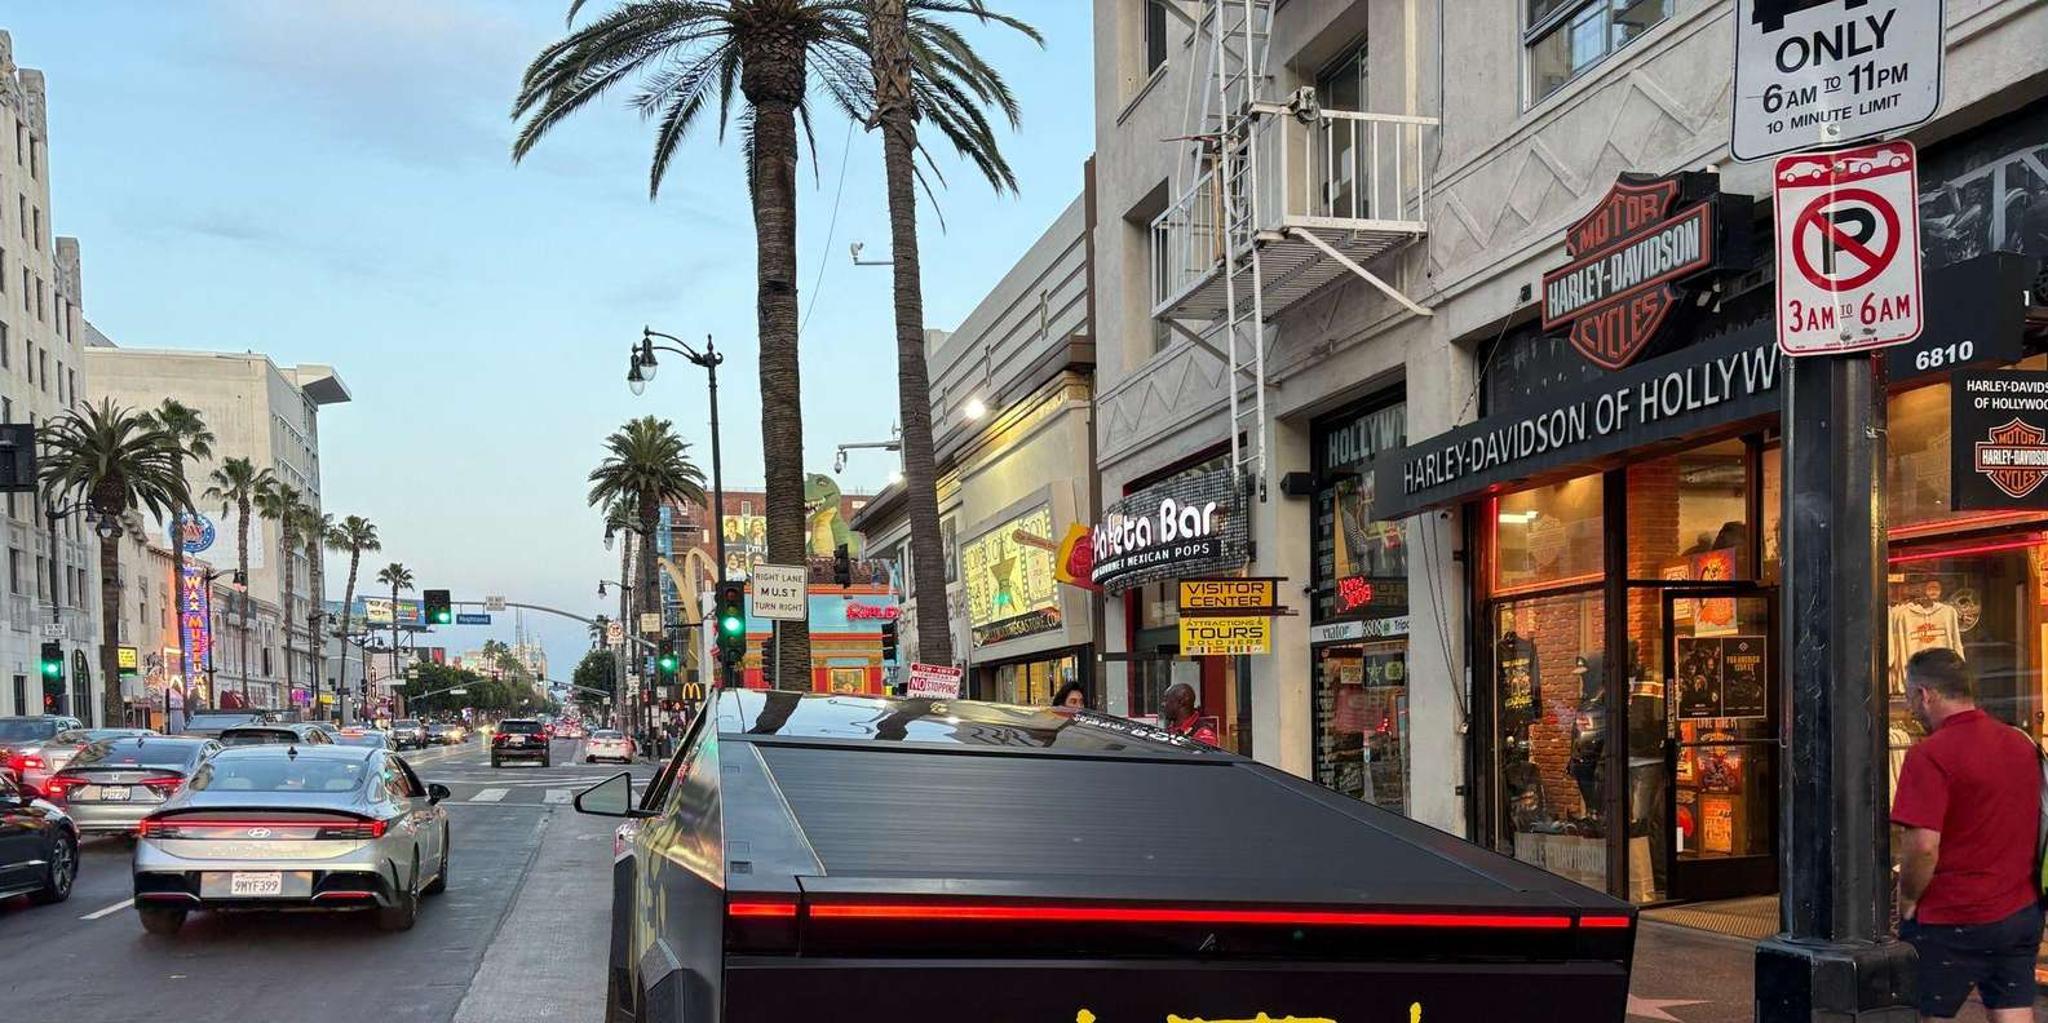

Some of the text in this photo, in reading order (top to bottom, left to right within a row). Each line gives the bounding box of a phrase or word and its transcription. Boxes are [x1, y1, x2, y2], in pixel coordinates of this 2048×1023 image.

[1775, 8, 1896, 73] ONLY
[1763, 61, 1908, 113] 6AM TO 11PM
[1767, 93, 1902, 134] 10 MINUTE LIMIT
[1579, 193, 1660, 249] MOTOR
[1548, 217, 1699, 319] HARLEY-DAVIDSON
[1581, 291, 1659, 357] CYCLES
[1789, 291, 1911, 333] 3AM TO 6AM
[1915, 340, 1974, 371] 6810
[1974, 397, 1990, 409] OF
[1404, 342, 1778, 494] HARLEY-DAVIDSON OF HOLLYW
[1999, 427, 2036, 444] MOTOR
[1999, 470, 2036, 491] CYCLES
[1160, 498, 1217, 543] Bar
[1127, 549, 1169, 566] MEXICAN
[1175, 543, 1210, 557] POPS
[755, 573, 803, 582] RIGHT LANE
[1187, 583, 1265, 594] VISITOR
[186, 577, 201, 610] WAX
[761, 587, 797, 597] MUST
[1190, 596, 1262, 606] CENTER
[779, 603, 803, 612] RIGHT
[1186, 619, 1255, 627] ATTRACTIONS
[1187, 628, 1264, 639] TOURS
[188, 616, 206, 686] MUSEUM
[911, 678, 957, 694] NO STOPPING
